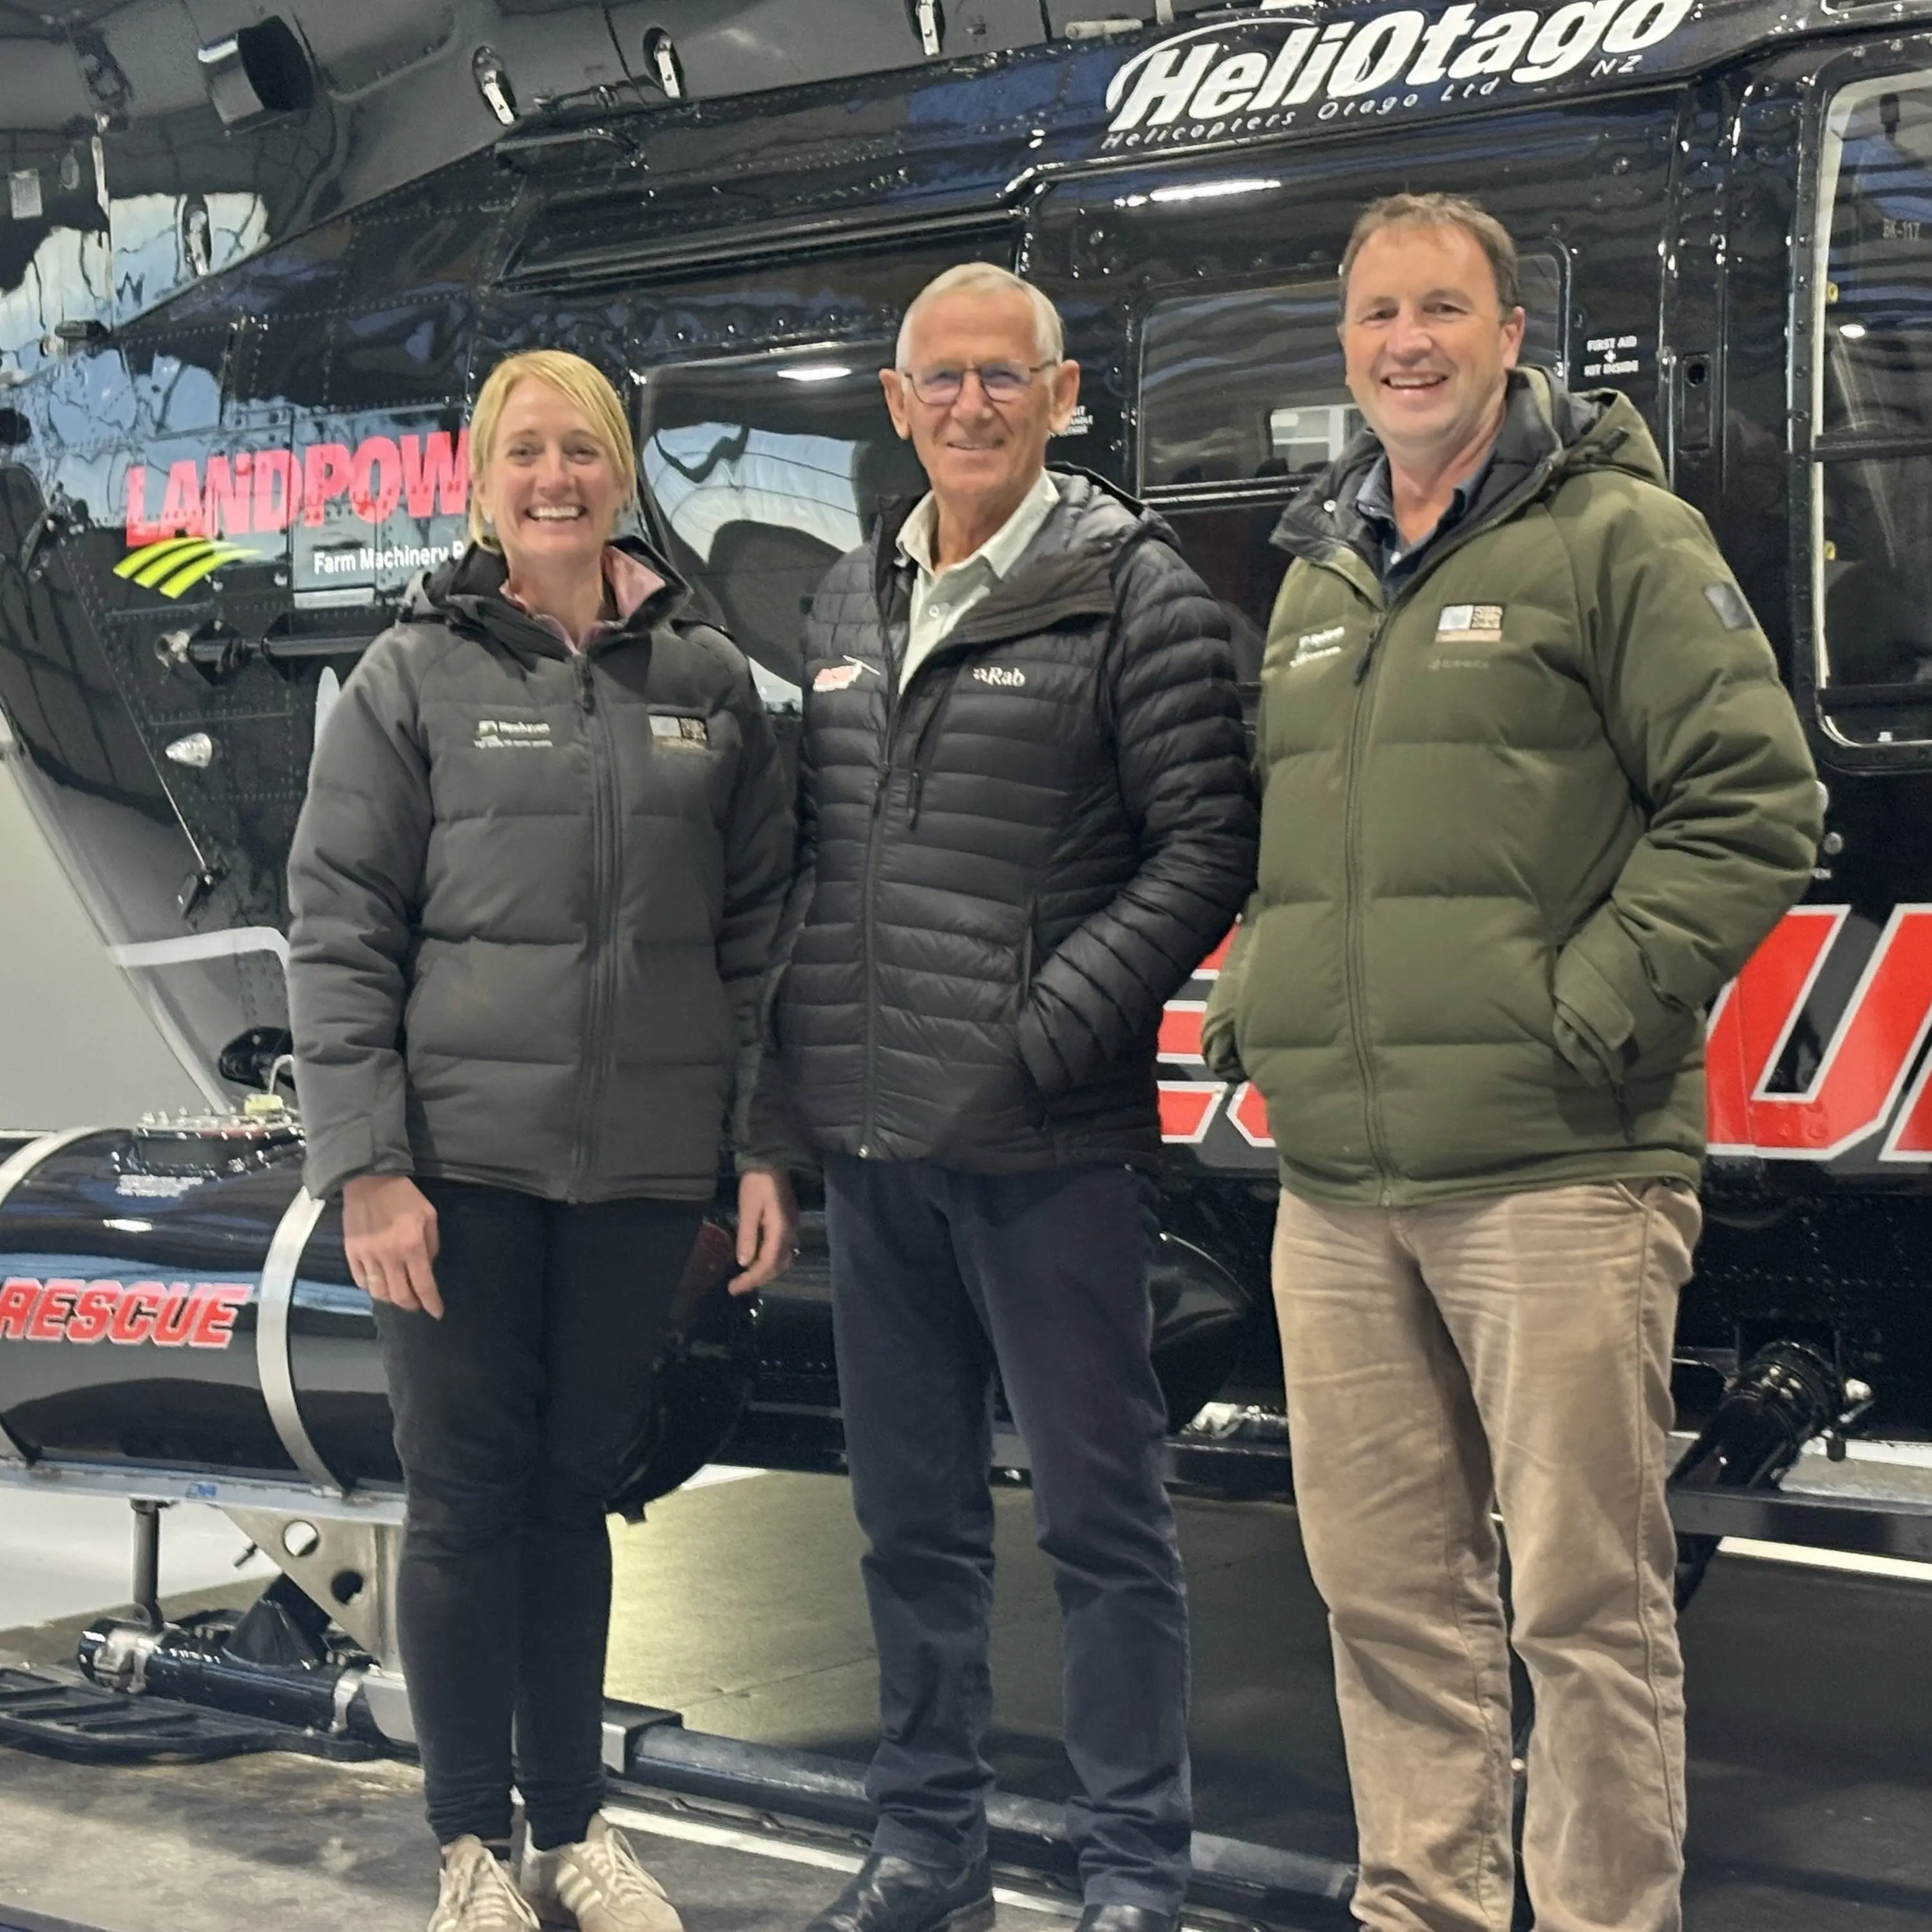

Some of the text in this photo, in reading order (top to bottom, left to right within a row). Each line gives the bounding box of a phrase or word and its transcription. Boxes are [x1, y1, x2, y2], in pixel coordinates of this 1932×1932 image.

[1101, 55, 1643, 150] Helicopters Otago Ltd NZ
[1106, 0, 1694, 133] HeliOtago
[126, 429, 470, 547] LANDPOW
[314, 552, 356, 574] Farm
[987, 667, 1025, 687] Rab
[0, 1277, 254, 1349] RESCUE
